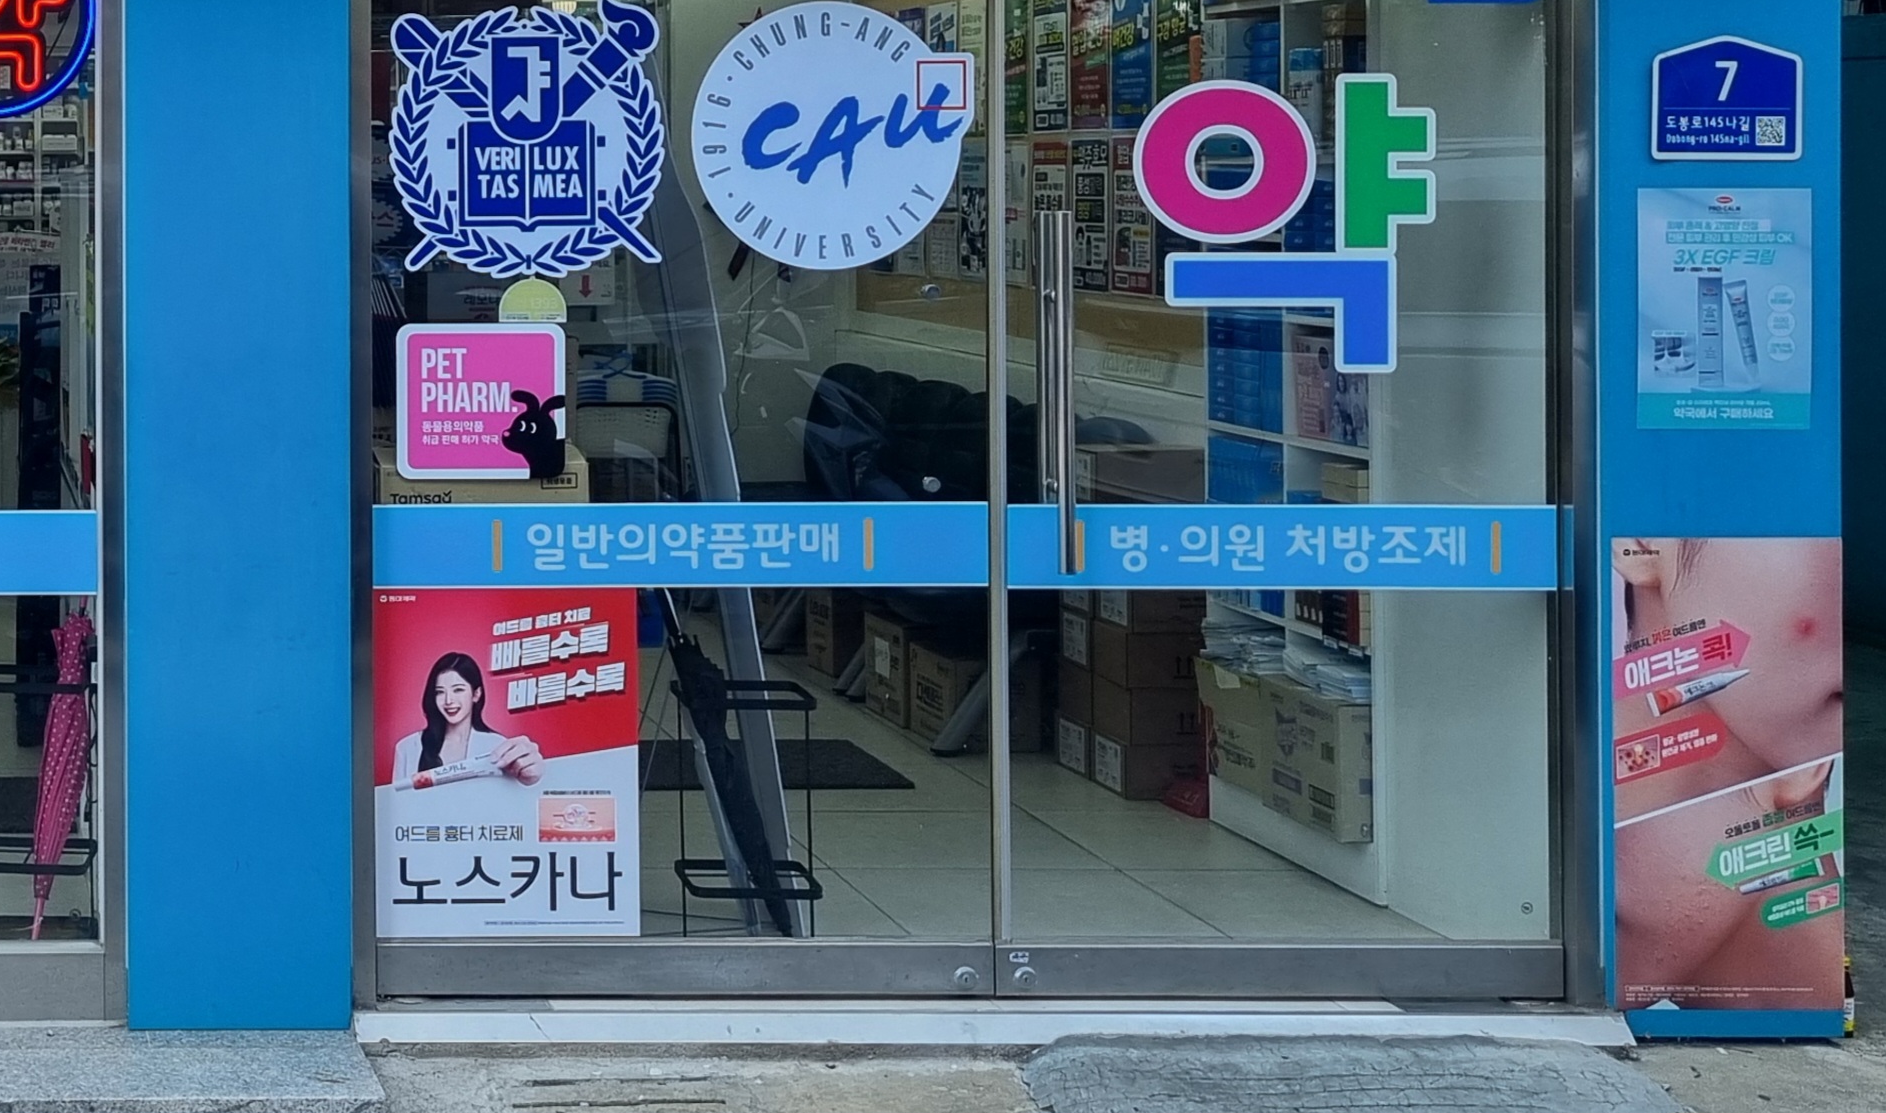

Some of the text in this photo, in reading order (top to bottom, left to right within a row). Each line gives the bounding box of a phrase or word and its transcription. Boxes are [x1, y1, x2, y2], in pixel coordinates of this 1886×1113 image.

[701, 11, 913, 180] 1916 CHUNG-ANG
[1715, 61, 1738, 101] 7
[741, 83, 963, 189] CAU
[1666, 116, 1750, 131] 도봉로145나길
[1666, 134, 1750, 145] Dobong-ro 145na-gil
[474, 146, 579, 171] VERI LUX
[478, 174, 583, 199] TAS MEA
[734, 183, 938, 261] UNIVERSITY
[1133, 73, 1437, 373] 약
[1777, 233, 1793, 243] OK
[1673, 249, 1776, 265] 3X EGF 크림
[421, 348, 467, 379] PET
[421, 382, 518, 413] PHARM.
[1674, 407, 1774, 419] 약국에서 구매하세요
[422, 421, 483, 432] 동물용의약품
[422, 435, 439, 445] 취급
[442, 435, 459, 445] 판매
[482, 435, 499, 444] 약국
[527, 522, 839, 571] 일반의약품판매
[1111, 524, 1467, 574] 병·의원 처방조제
[490, 624, 609, 673] 빠를수록
[1625, 647, 1699, 689] 애크논
[507, 662, 625, 711] 바를수록
[395, 825, 523, 842] 여드름 흉터 치료제
[1719, 832, 1791, 876] 애크린
[393, 852, 623, 911] 노스카나
